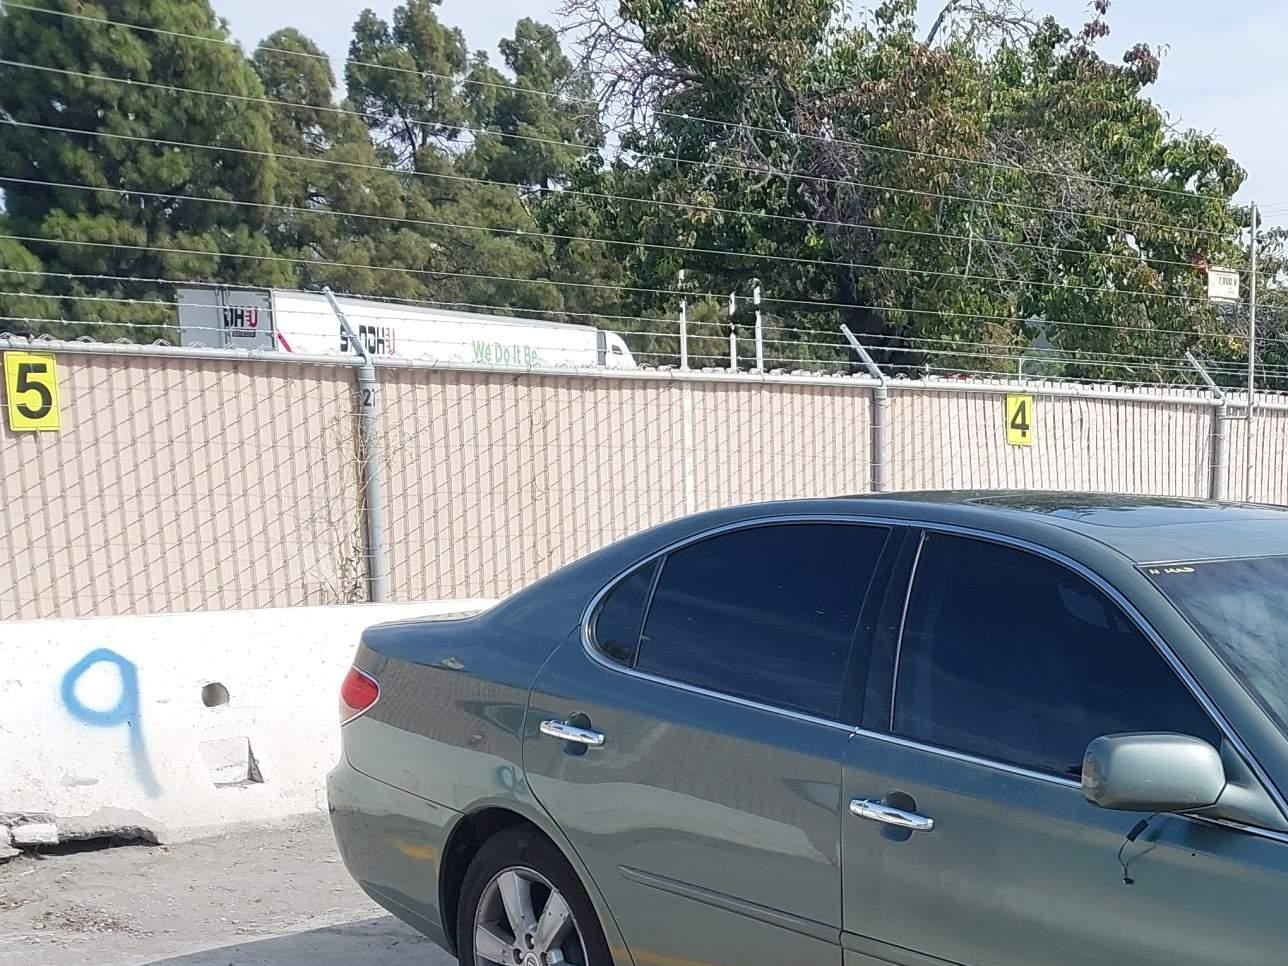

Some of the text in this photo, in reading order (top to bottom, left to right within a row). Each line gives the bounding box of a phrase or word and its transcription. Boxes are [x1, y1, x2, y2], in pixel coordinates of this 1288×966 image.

[472, 340, 492, 362] We
[494, 342, 510, 363] Do
[16, 362, 53, 420] 5
[1010, 399, 1030, 438] 4
[60, 647, 163, 800] 9
